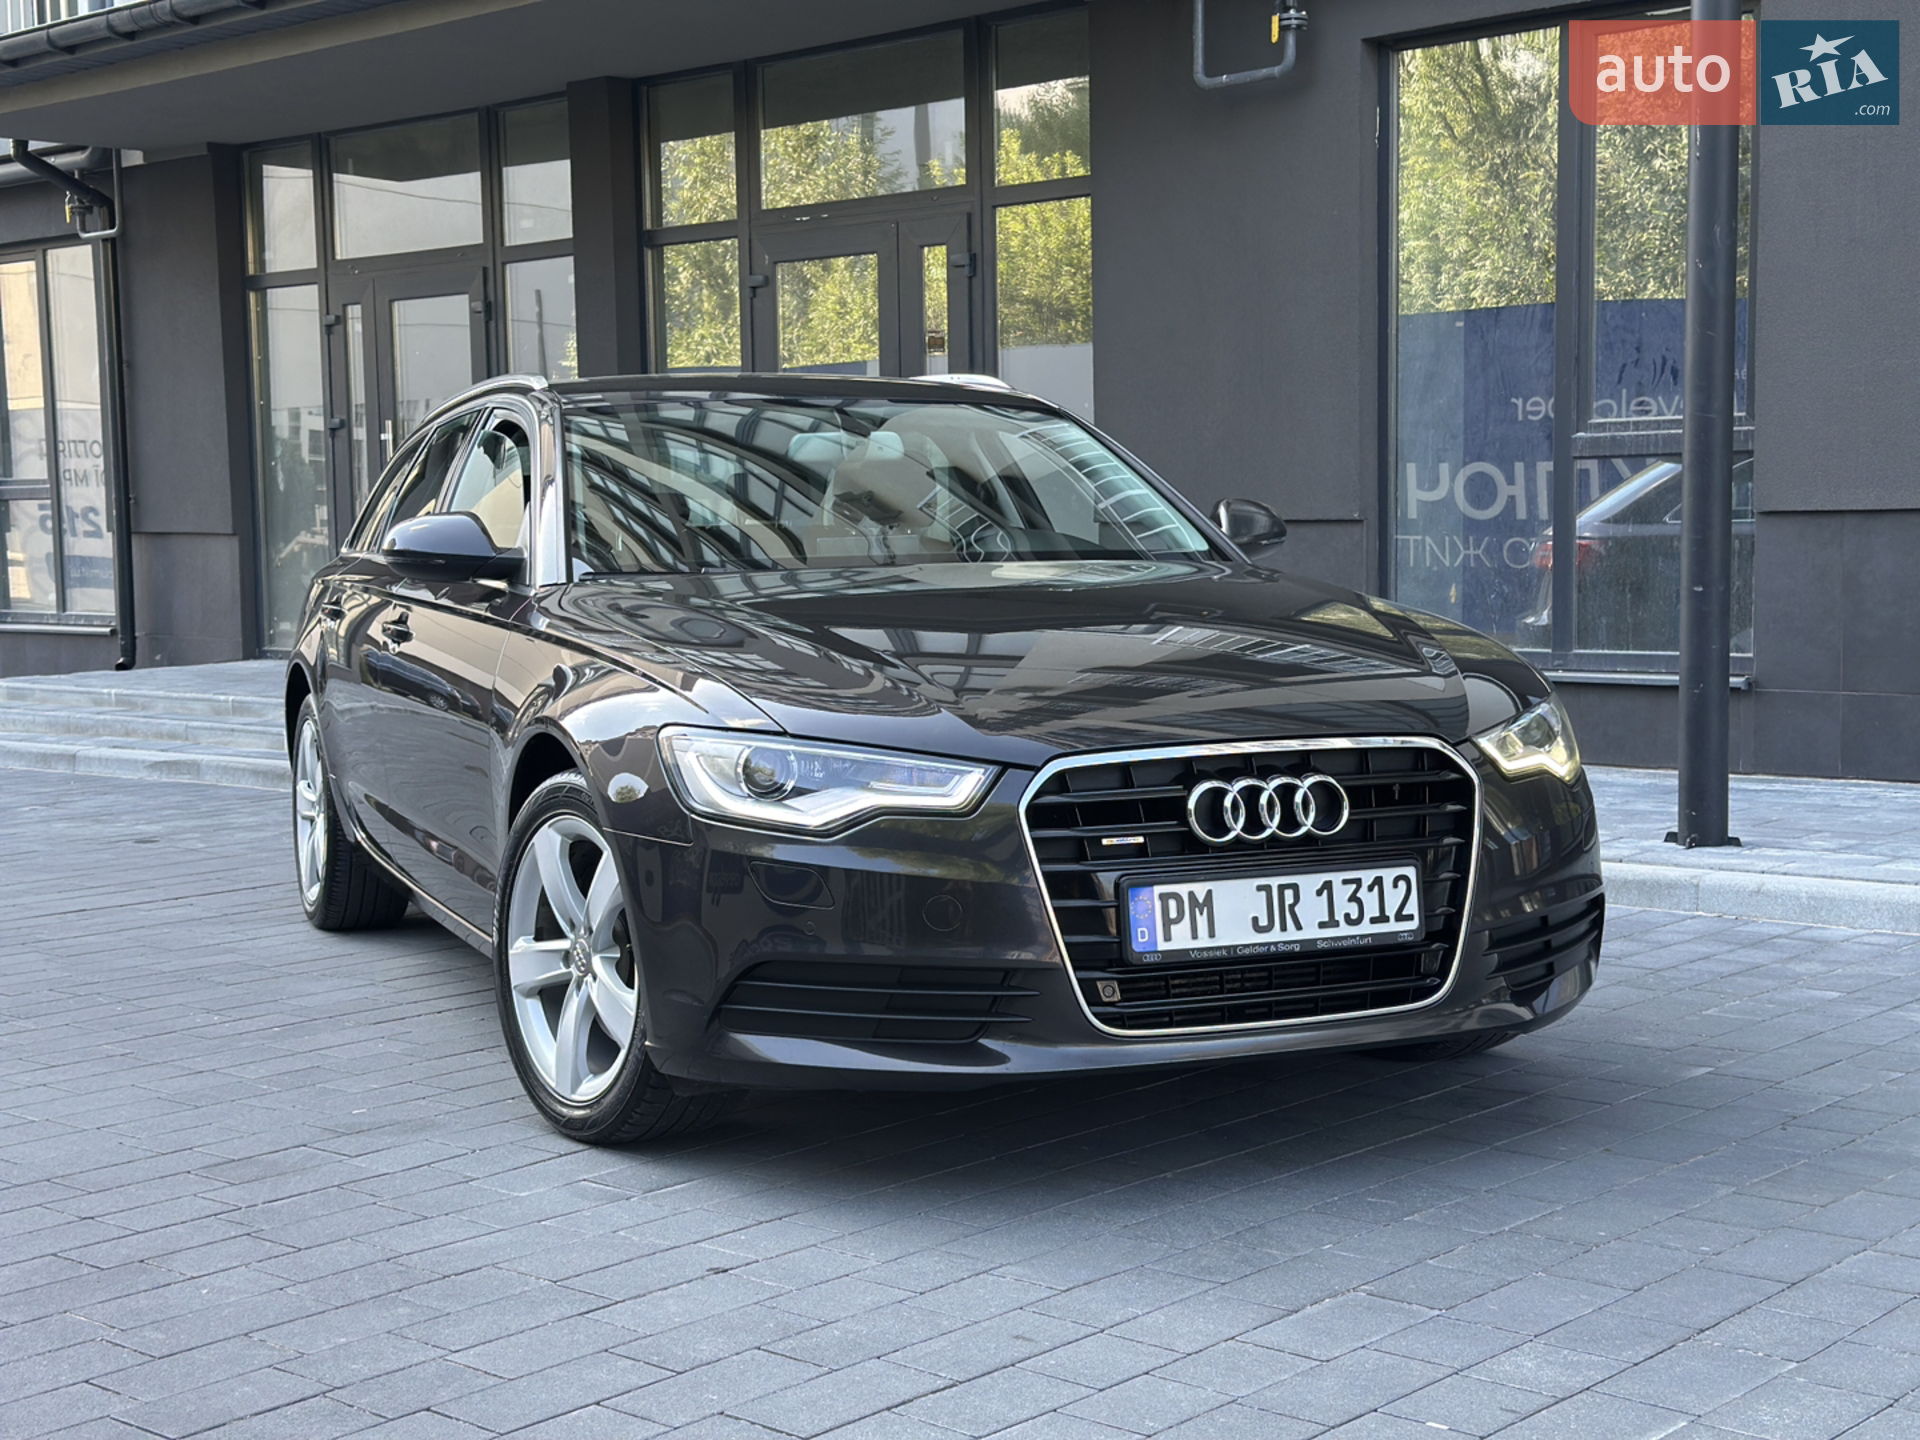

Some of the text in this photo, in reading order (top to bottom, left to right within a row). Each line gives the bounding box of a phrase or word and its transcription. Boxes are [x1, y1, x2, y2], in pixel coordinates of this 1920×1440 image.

[1158, 874, 1415, 942] PM JR 1312
[1137, 927, 1149, 942] D
